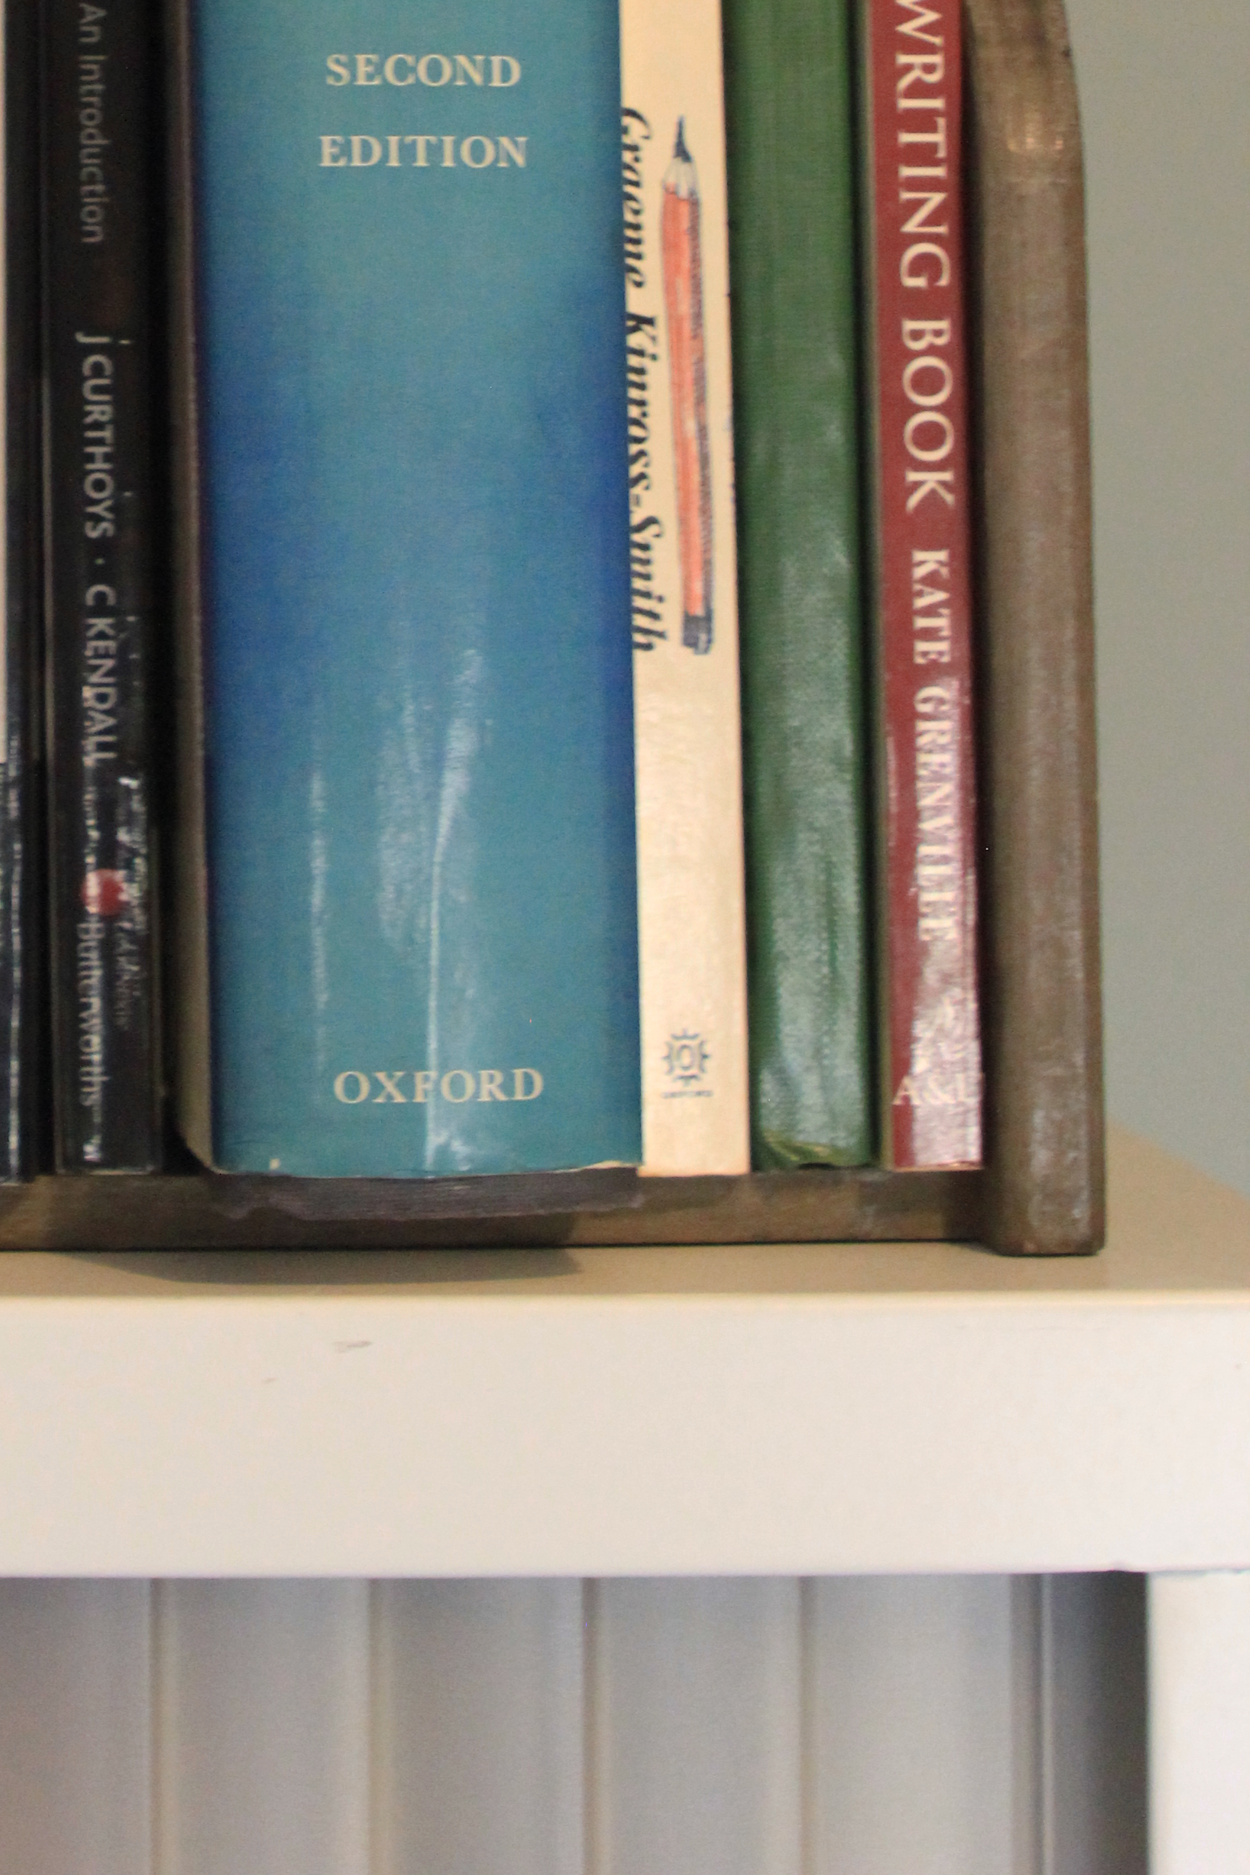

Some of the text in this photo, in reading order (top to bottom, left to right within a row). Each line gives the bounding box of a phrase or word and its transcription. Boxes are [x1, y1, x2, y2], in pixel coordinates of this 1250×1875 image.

[78, 2, 108, 43] An
[325, 53, 522, 87] SECOND
[78, 55, 111, 243] Introduction
[319, 135, 528, 168] EDITION
[81, 353, 115, 540] CURTHOYS
[899, 318, 955, 514] BOOK
[85, 583, 117, 607] C
[911, 548, 951, 665] KATE
[84, 616, 118, 763] KENDALL
[914, 685, 960, 943] GRENVILLE
[333, 1068, 544, 1104] OXFORD
